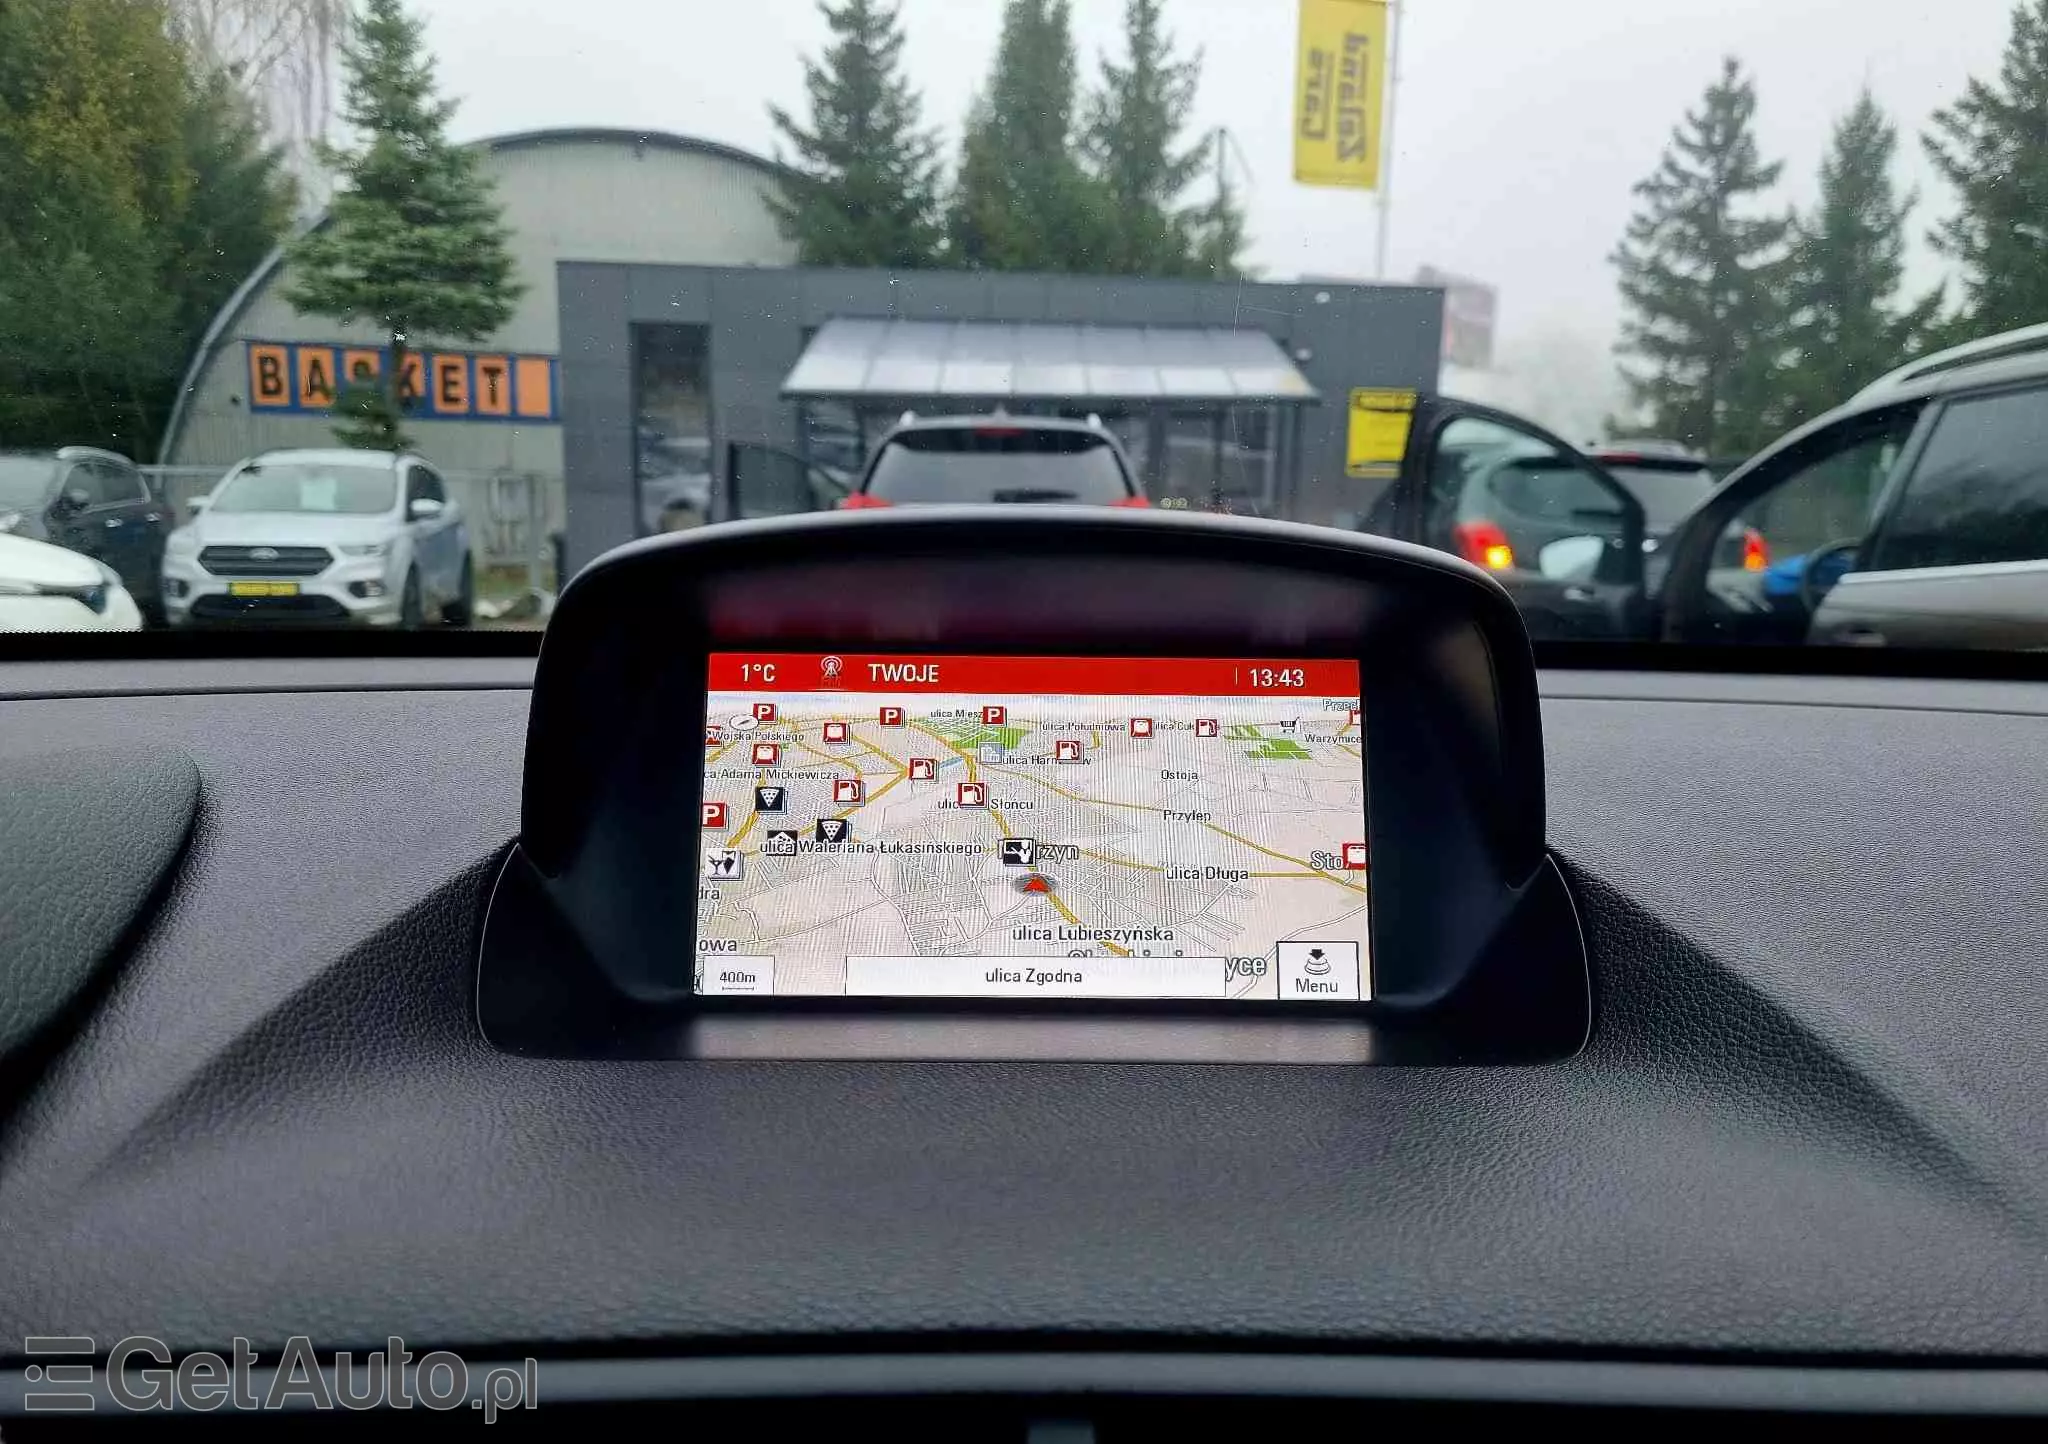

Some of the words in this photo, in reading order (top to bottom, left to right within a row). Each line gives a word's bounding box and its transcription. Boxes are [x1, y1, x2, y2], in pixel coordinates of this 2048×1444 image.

[741, 663, 776, 682] 1°C
[868, 663, 940, 683] TWOJE
[1250, 668, 1305, 687] 13:43
[930, 710, 953, 718] ulica
[713, 731, 751, 742] Wojska
[1003, 756, 1028, 765] ulica
[721, 768, 762, 780] Adama
[766, 768, 840, 780] Mickiewicza
[1161, 769, 1199, 782] Ostoja
[991, 798, 1034, 810] Słońcu
[760, 840, 793, 854] ulica
[799, 840, 875, 854] Waleriana
[880, 840, 982, 857] Łukasińskiego
[1166, 866, 1201, 881] ulica
[1205, 866, 1249, 883] Długa
[1012, 925, 1052, 942] ulica
[1058, 925, 1174, 945] Lubieszyńska
[719, 971, 756, 984] 400m
[985, 967, 1021, 983] ulica
[1025, 967, 1083, 987] Zgodna
[1295, 977, 1339, 993] Menu
